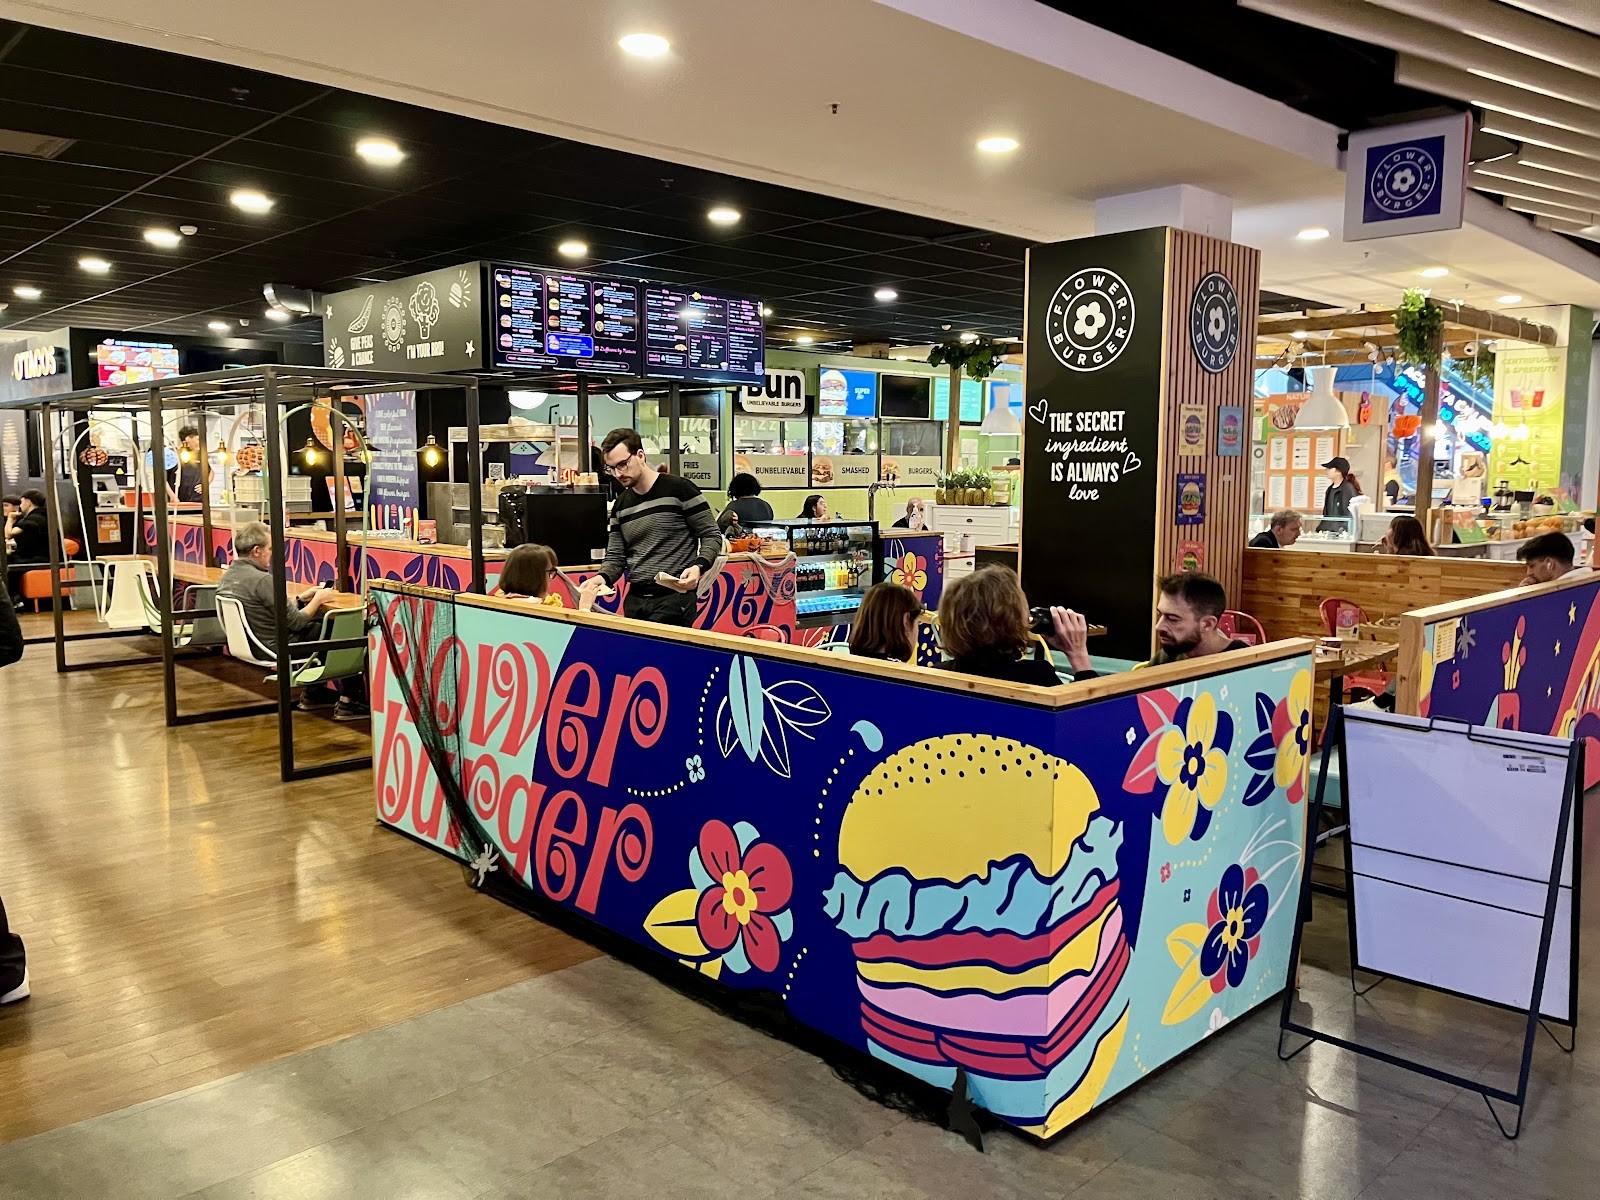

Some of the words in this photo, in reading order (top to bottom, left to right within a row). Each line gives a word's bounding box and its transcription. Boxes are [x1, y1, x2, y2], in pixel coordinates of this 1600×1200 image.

[1377, 152, 1431, 179] FLOWER
[1377, 183, 1430, 209] BURGER
[1053, 275, 1127, 315] FLOWER
[1196, 281, 1236, 315] FLOWER
[350, 337, 361, 350] GIVE
[361, 335, 374, 349] PEAS
[416, 342, 430, 358] YOUR
[1053, 327, 1127, 365] BURGER
[1196, 332, 1235, 366] BURGER
[13, 345, 56, 380] O'TACOS
[351, 352, 356, 366] A
[355, 350, 374, 365] CHANCE
[1049, 412, 1073, 432] THE
[1076, 411, 1125, 432] SECRET
[1045, 436, 1128, 460] ingredient
[683, 462, 699, 470] FRIES
[683, 472, 711, 480] NUGGETS
[755, 466, 805, 475] BUNBELIEVABLE
[1051, 462, 1064, 481] IS
[1066, 462, 1119, 482] ALWAYS
[1068, 484, 1099, 500] love
